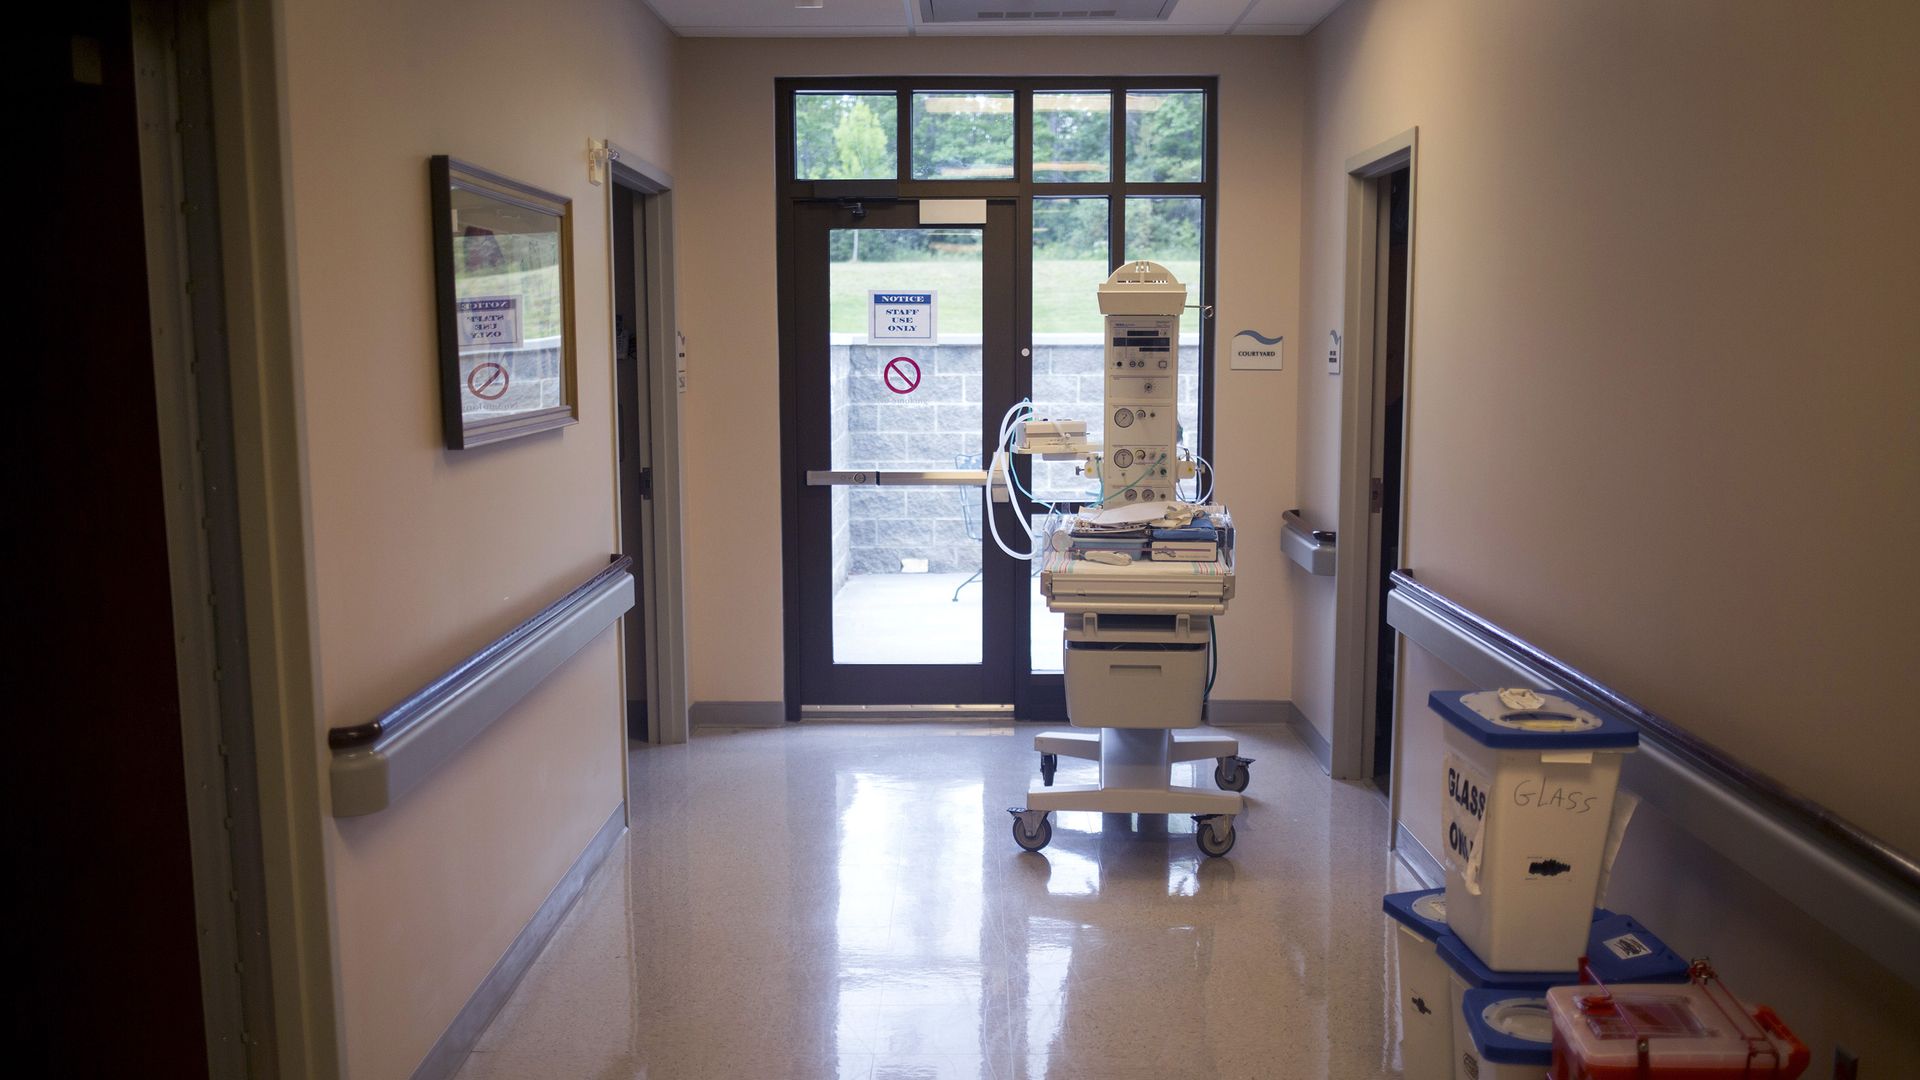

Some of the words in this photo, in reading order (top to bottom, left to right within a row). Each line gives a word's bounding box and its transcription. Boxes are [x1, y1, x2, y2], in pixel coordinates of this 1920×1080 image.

[882, 295, 924, 303] NOTICE
[1448, 767, 1486, 821] GLASS
[1513, 775, 1598, 814] GLASS
